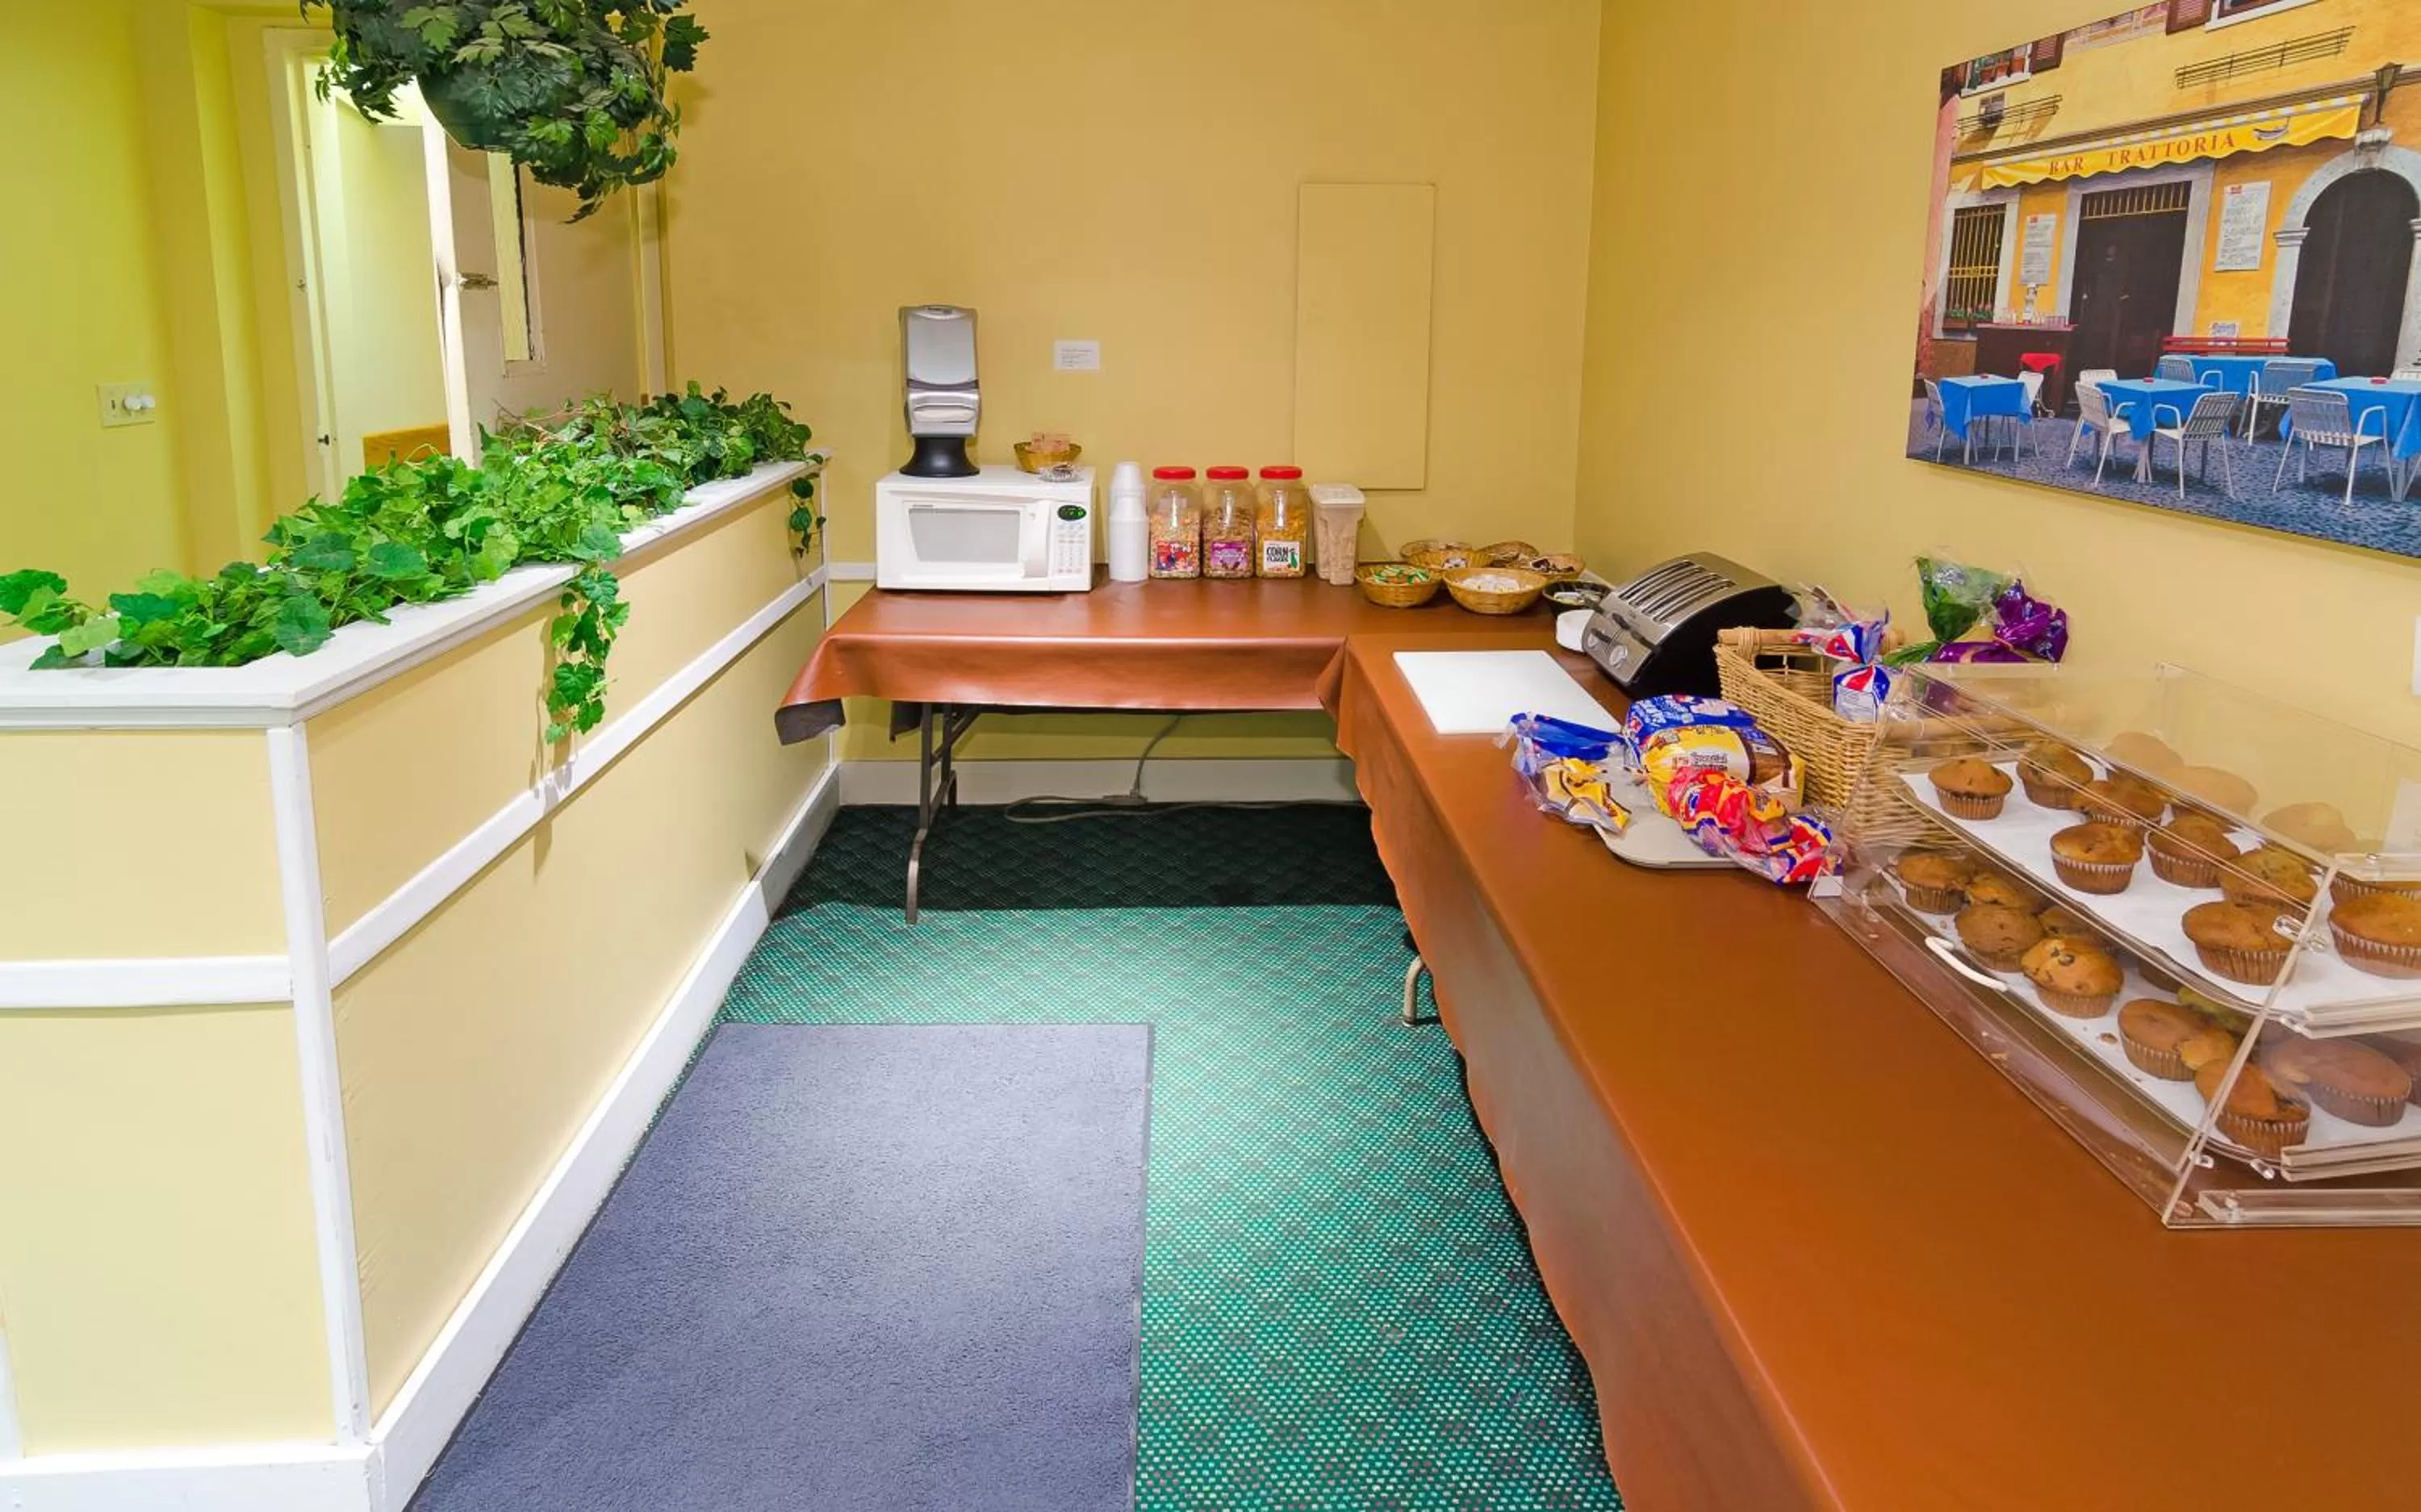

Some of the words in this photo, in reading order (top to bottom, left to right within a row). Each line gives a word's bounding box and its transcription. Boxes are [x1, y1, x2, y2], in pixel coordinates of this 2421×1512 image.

[2048, 156, 2084, 175] BAR
[2106, 132, 2235, 168] TRATTORIA
[1266, 546, 1289, 557] CORN
